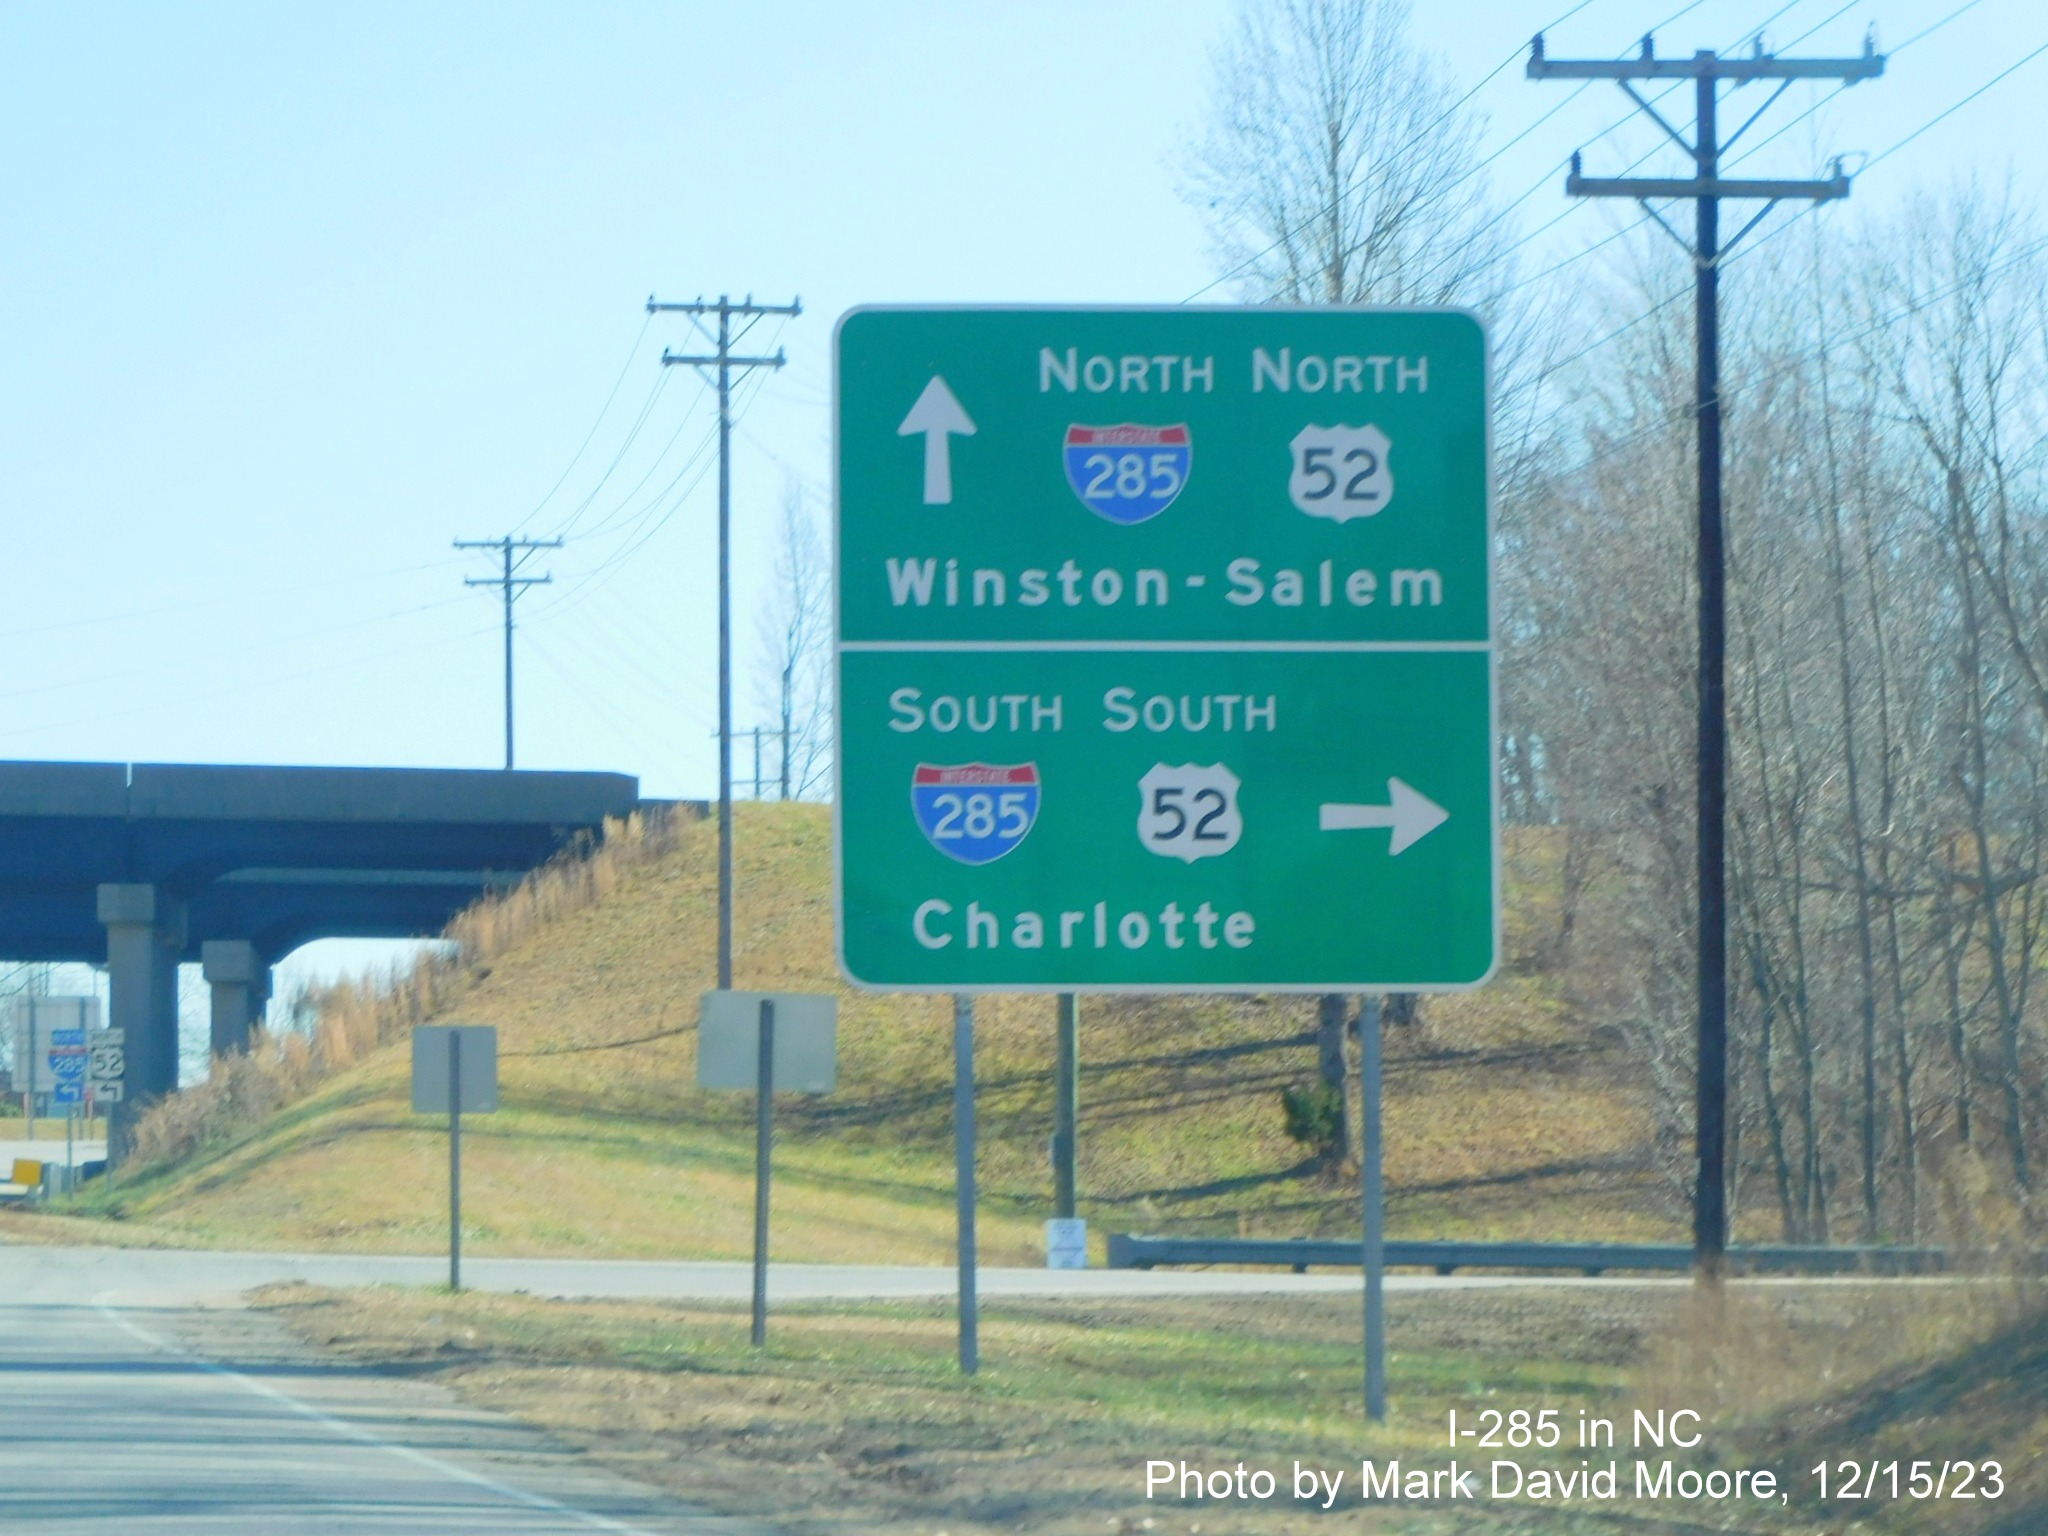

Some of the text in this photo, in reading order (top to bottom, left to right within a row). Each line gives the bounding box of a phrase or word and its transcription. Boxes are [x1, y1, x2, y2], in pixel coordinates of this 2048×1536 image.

[1040, 346, 1428, 393] NORTH NORTH
[1084, 453, 1180, 499] 285
[1303, 447, 1379, 500] 52
[888, 686, 1277, 733] SOUTH SOUTH
[932, 793, 1029, 839] 285
[1152, 787, 1228, 840] 52
[913, 898, 1256, 951] Charlotte
[95, 1053, 121, 1071] 52
